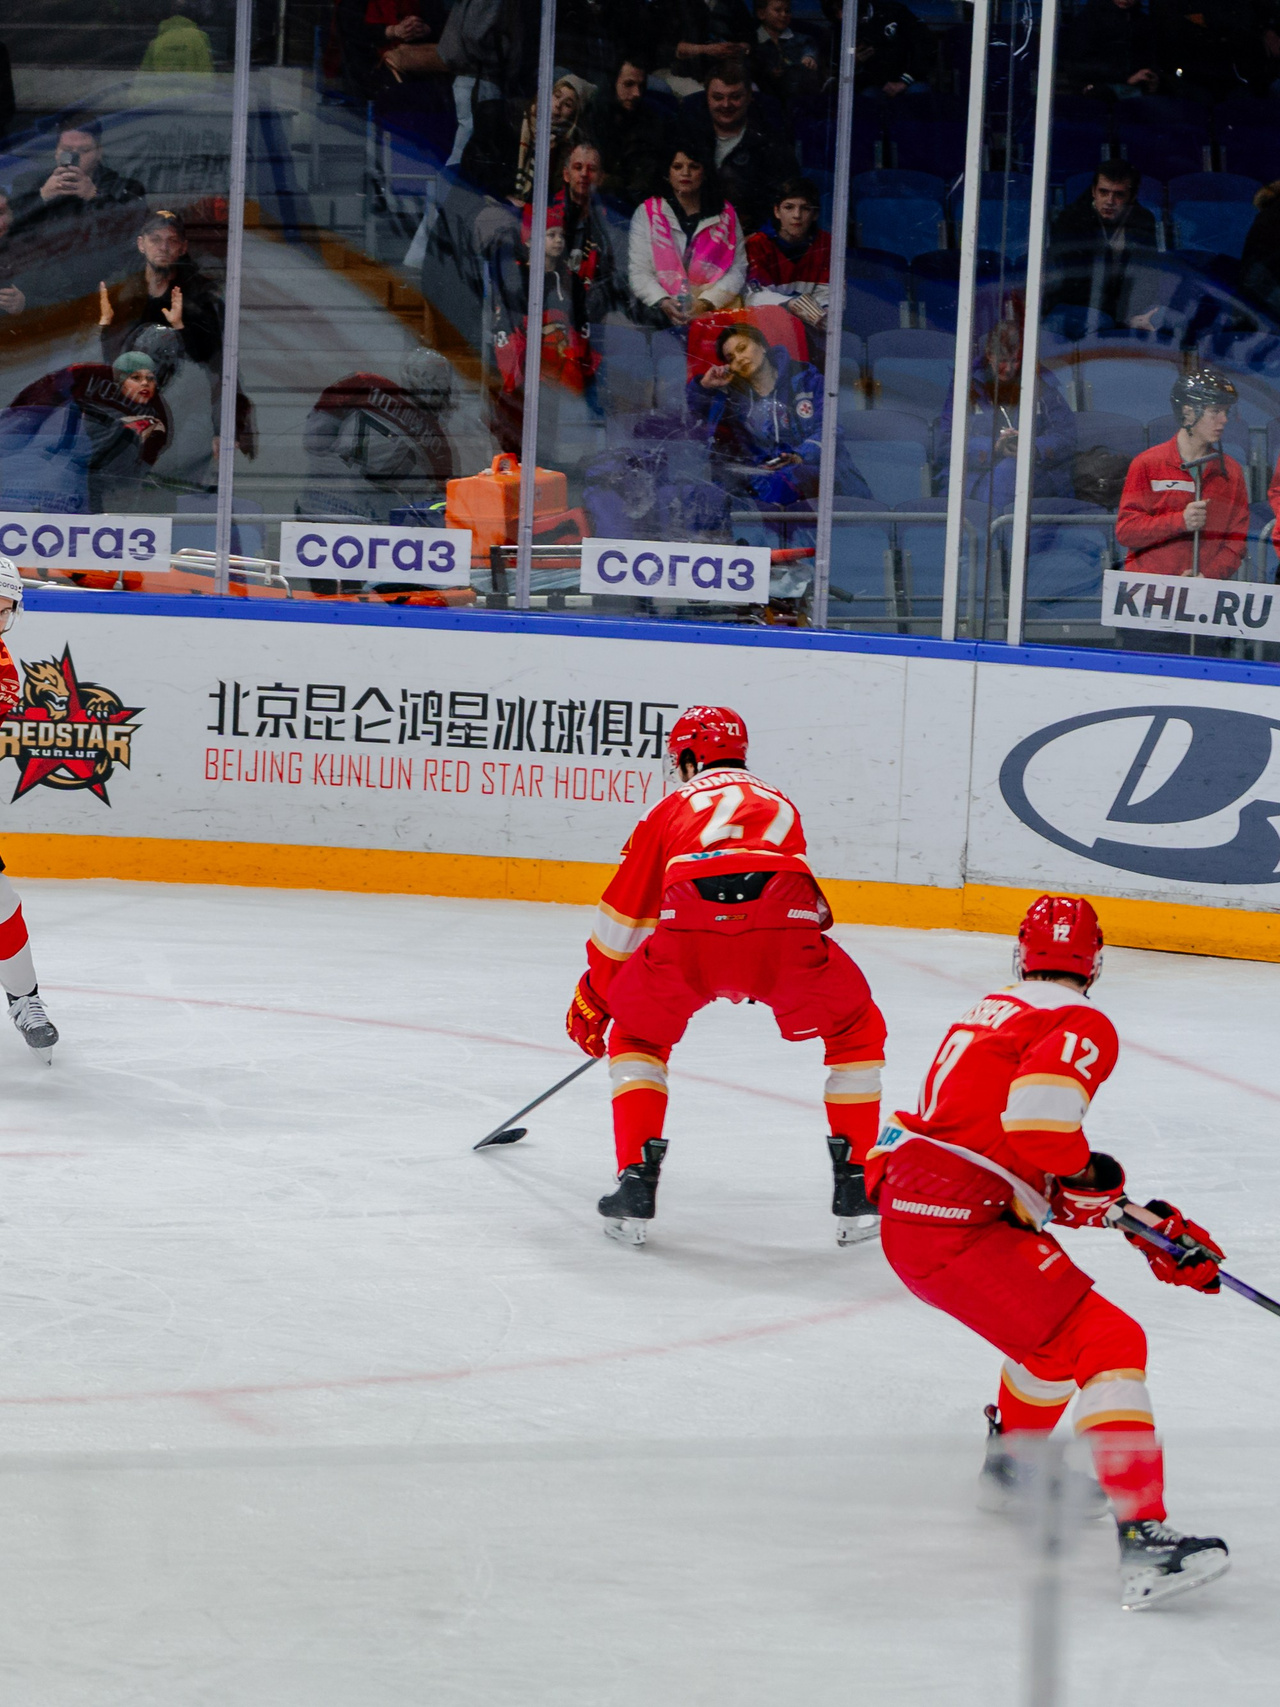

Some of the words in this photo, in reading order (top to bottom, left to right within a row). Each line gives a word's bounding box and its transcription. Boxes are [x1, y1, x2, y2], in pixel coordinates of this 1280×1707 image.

[296, 533, 456, 573] согаз
[597, 549, 755, 592] согаз
[1113, 581, 1273, 629] KHL.RU
[725, 722, 741, 737] 27
[204, 747, 303, 785] BEIJING
[314, 752, 413, 791] KUNLUN
[423, 759, 471, 793] RED
[481, 761, 544, 798] STAR
[554, 765, 653, 804] HOCKEY
[689, 784, 795, 848] 27
[1053, 923, 1070, 943] 12
[1060, 1031, 1100, 1080] 12
[891, 1198, 972, 1220] WARRIOR
